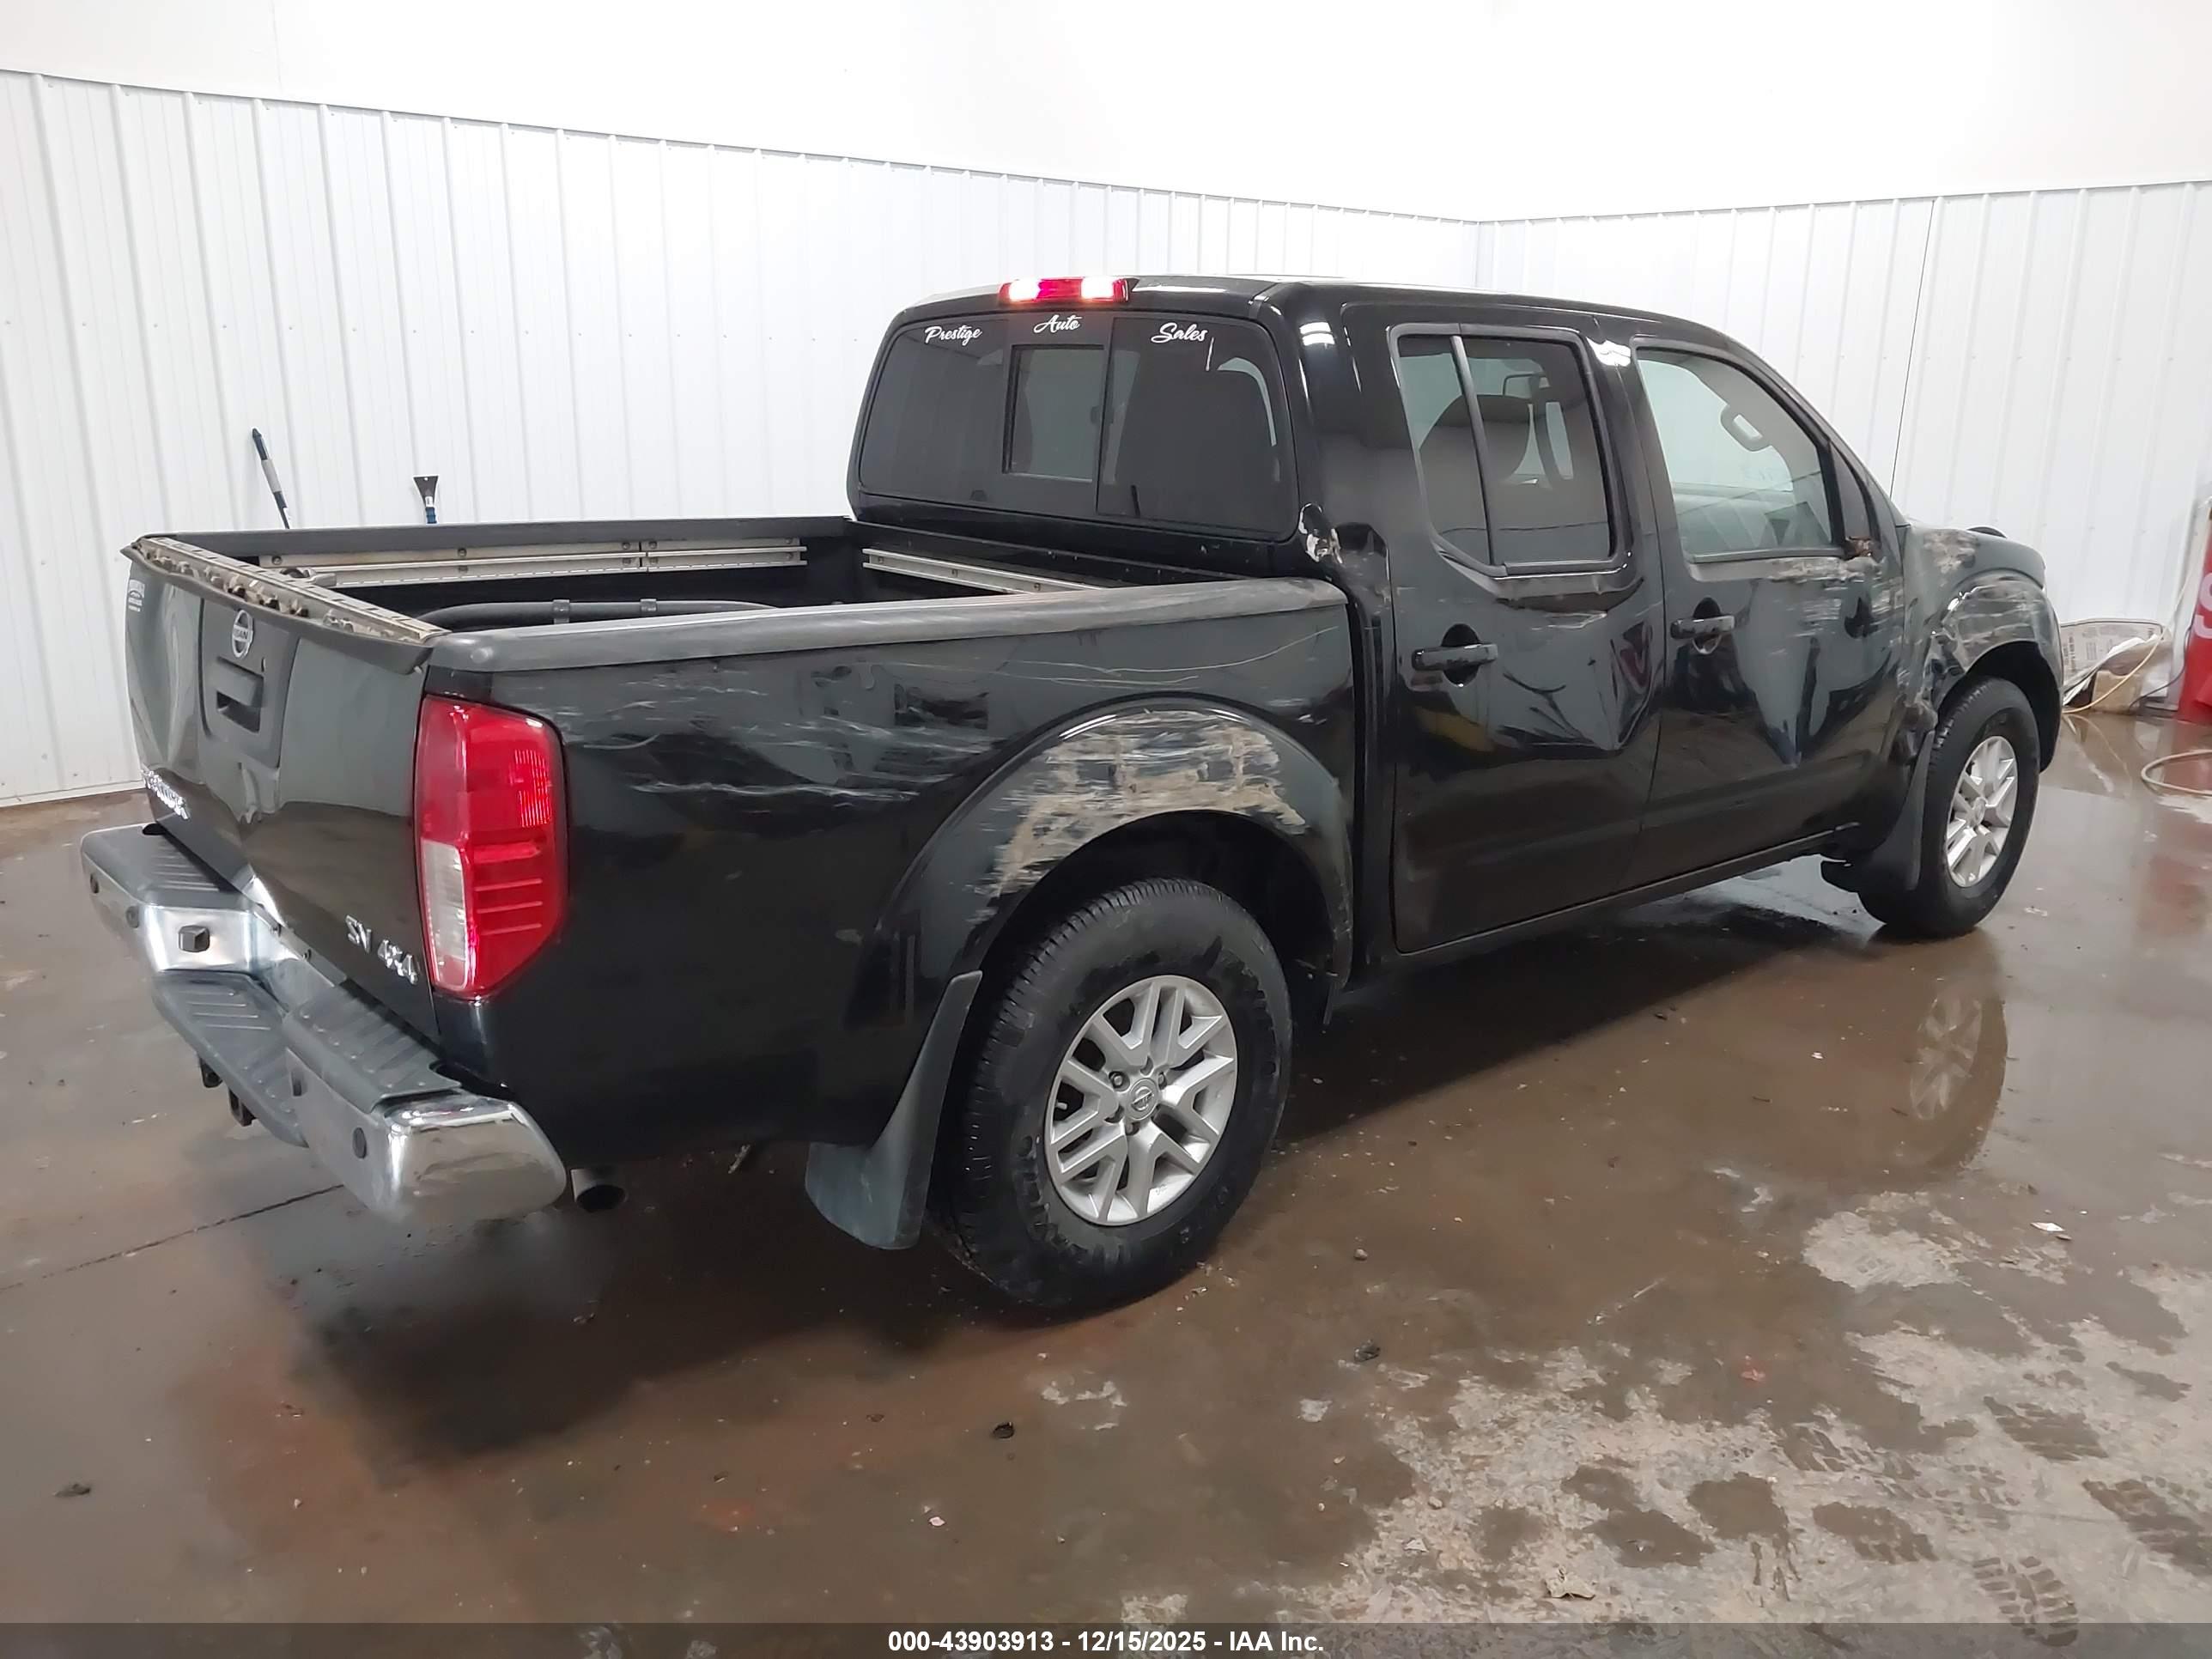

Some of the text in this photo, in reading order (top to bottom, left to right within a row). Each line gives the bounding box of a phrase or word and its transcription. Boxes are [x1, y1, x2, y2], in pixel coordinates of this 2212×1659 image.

[924, 314, 1207, 345] Prestige Auto Sales
[345, 915, 371, 953] SV
